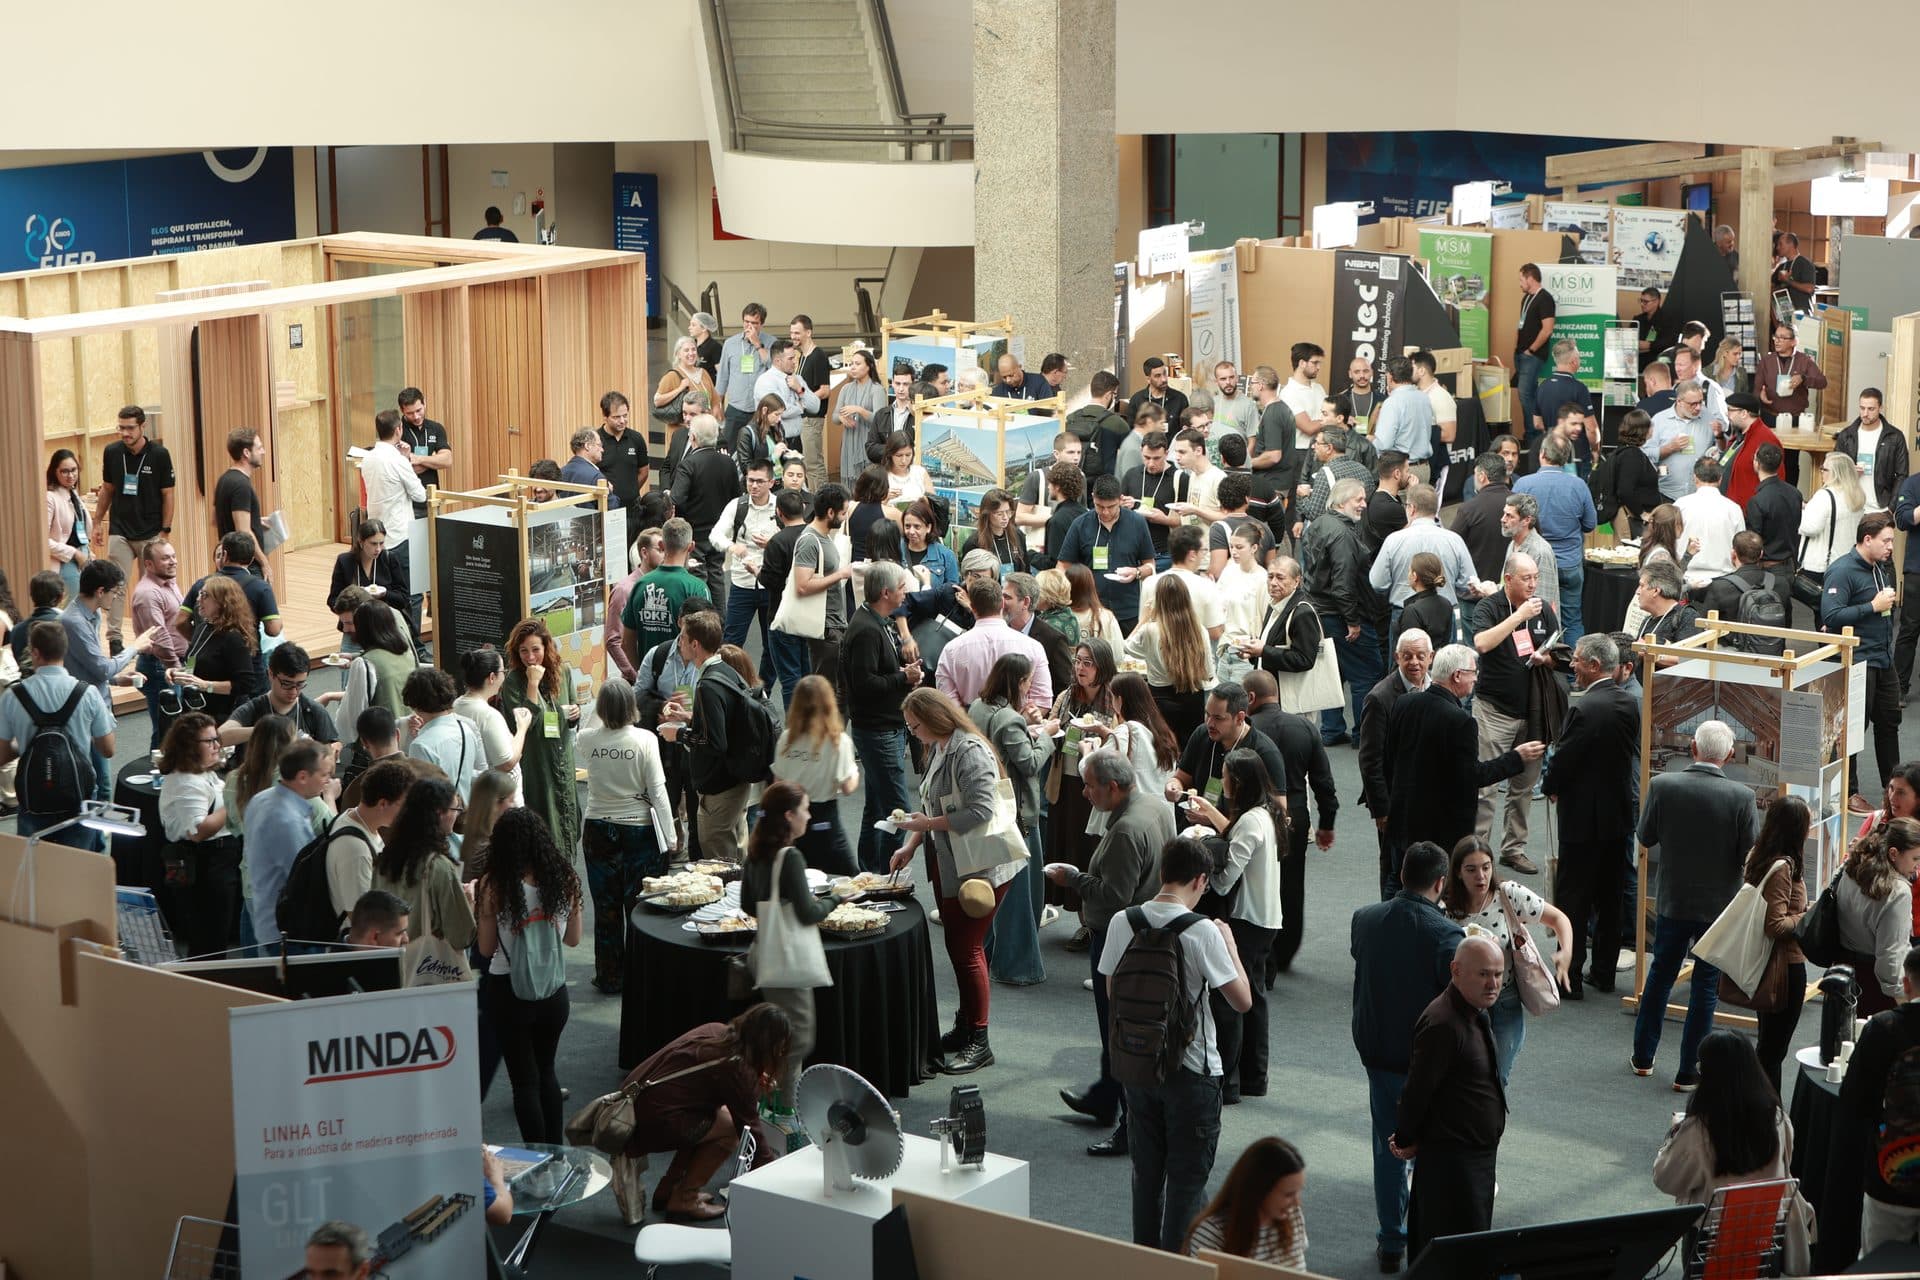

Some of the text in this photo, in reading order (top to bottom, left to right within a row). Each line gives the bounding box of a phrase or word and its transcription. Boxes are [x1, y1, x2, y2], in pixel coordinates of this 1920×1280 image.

[630, 191, 642, 207] A
[1416, 200, 1454, 216] FIE
[151, 219, 232, 235] ELOS QUE FORTALECEM,
[151, 229, 244, 246] INSPIRAM E TRANSFORMAM
[1551, 276, 1593, 289] MSM
[1383, 290, 1395, 329] technology
[1551, 332, 1600, 340] ARA MADEIRA
[1380, 329, 1391, 361] fastening
[643, 610, 668, 622] DKF
[591, 748, 635, 760] APOIO
[308, 1027, 438, 1075] MINDA
[263, 1118, 345, 1143] LINHA GLT
[264, 1147, 285, 1160] Para
[288, 1149, 294, 1158] a
[340, 1140, 353, 1152] de
[355, 1136, 393, 1151] madeira
[395, 1125, 458, 1147] engenheirada
[261, 1176, 333, 1227] GLT
